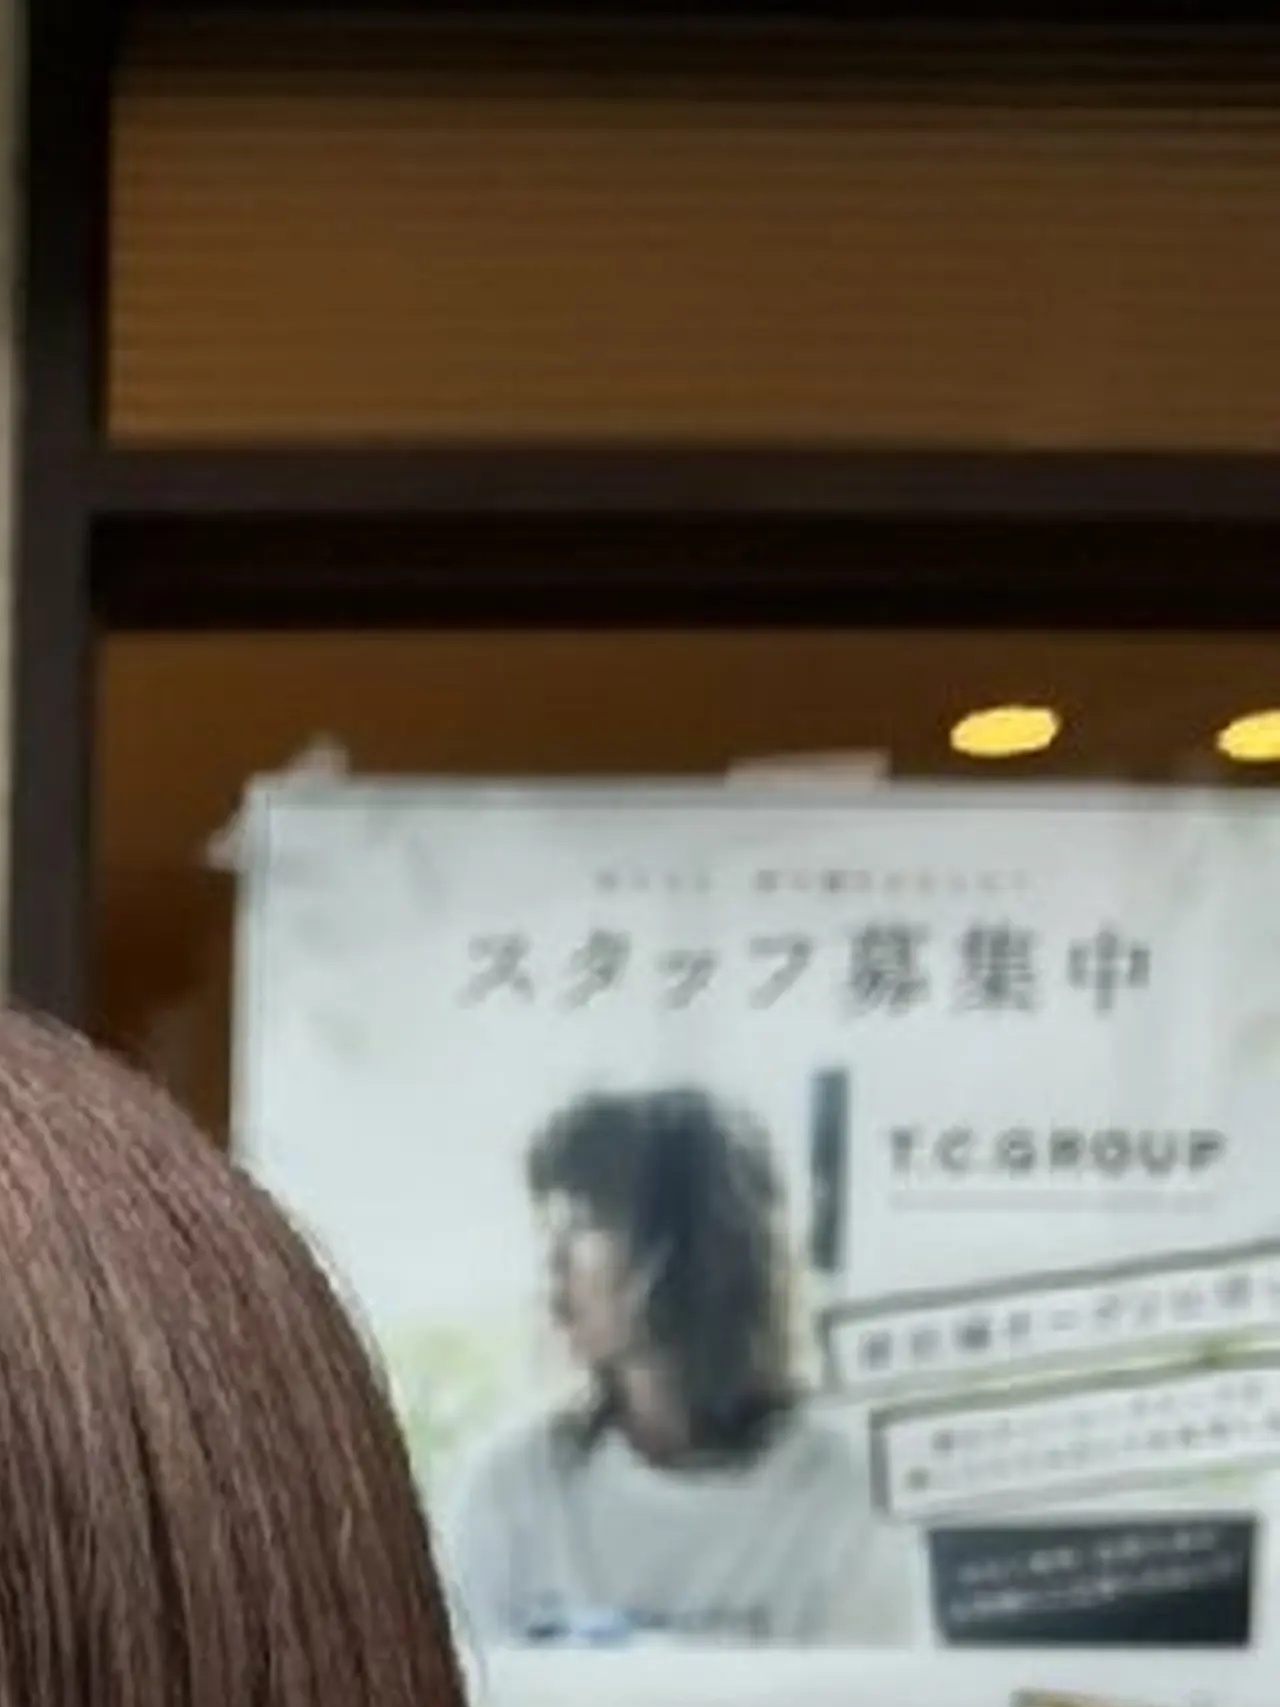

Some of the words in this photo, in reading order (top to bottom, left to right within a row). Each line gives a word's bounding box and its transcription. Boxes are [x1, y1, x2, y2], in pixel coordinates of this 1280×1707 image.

[456, 918, 1153, 1014] スタッフ募集中
